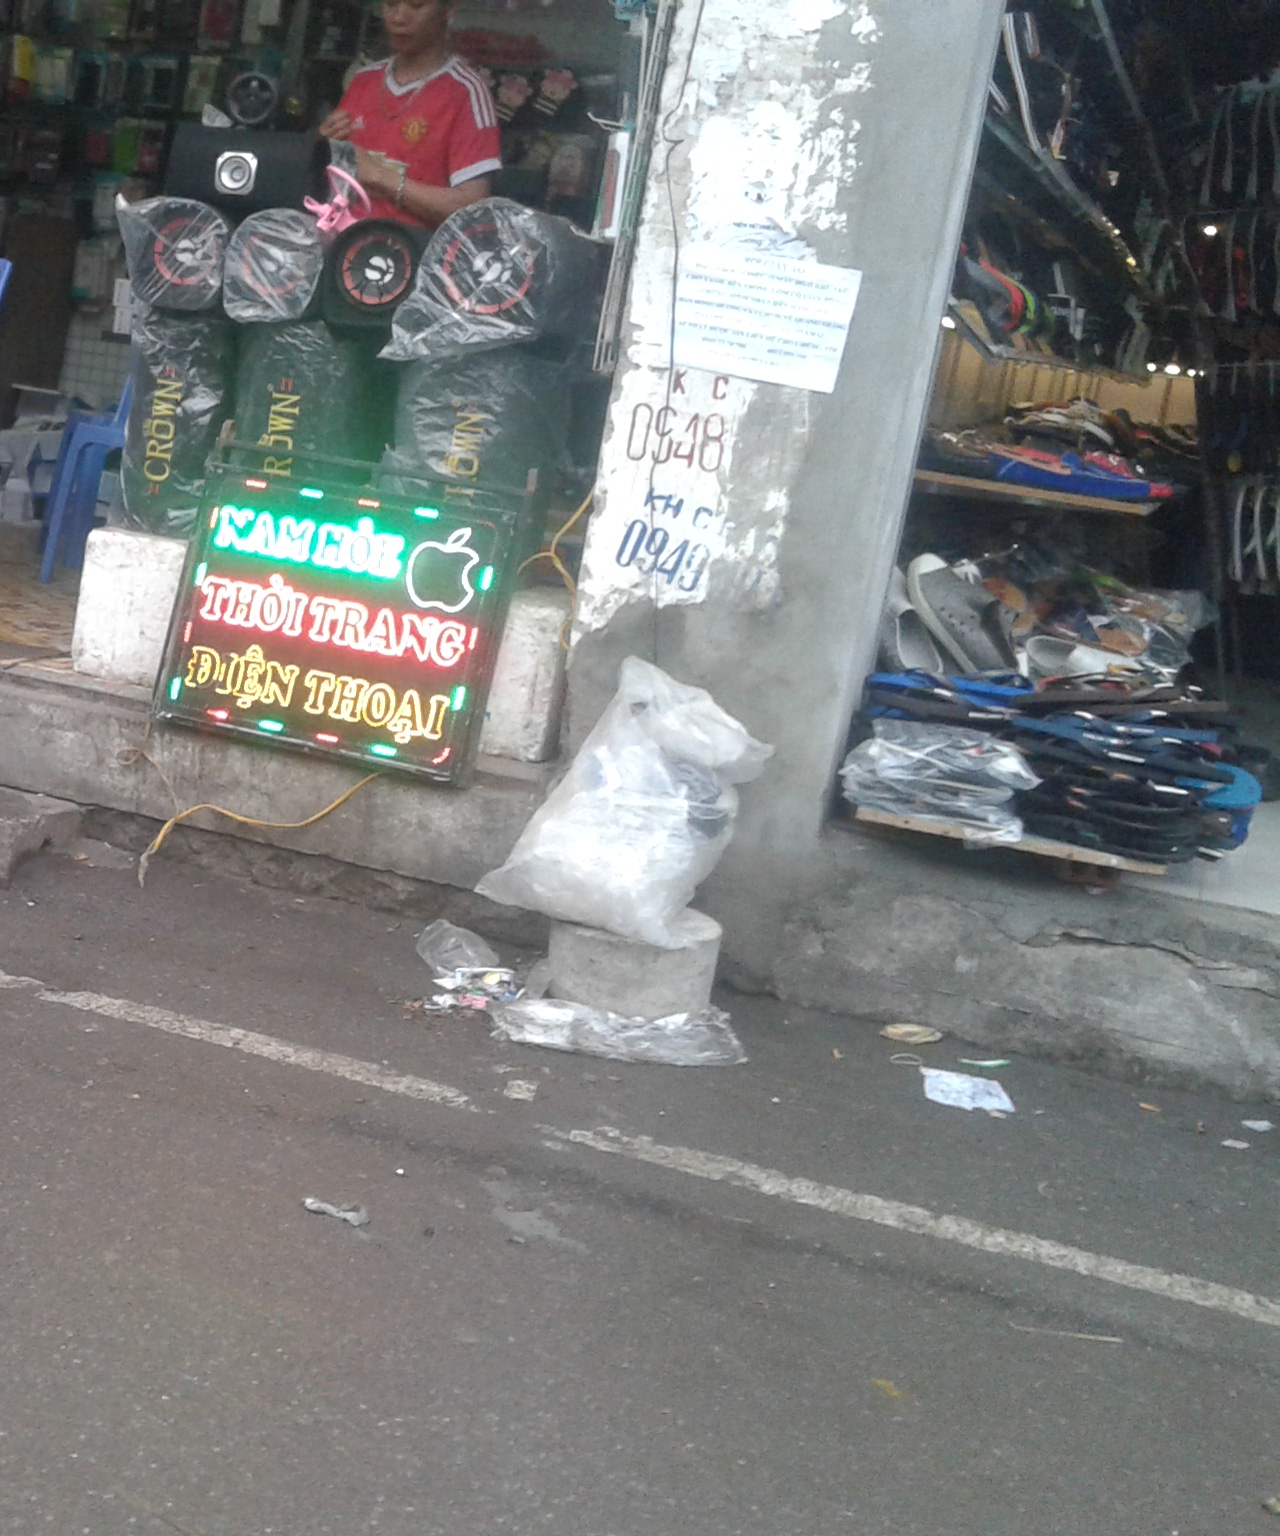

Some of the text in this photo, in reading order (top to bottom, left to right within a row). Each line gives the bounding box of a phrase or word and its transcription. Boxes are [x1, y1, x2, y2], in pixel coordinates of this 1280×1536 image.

[144, 378, 183, 483] CROWN
[263, 391, 302, 478] ROWN
[214, 505, 317, 562] NAM
[199, 573, 467, 668] THỜI TRANG
[184, 644, 452, 744] ĐIỆN THOẠI
